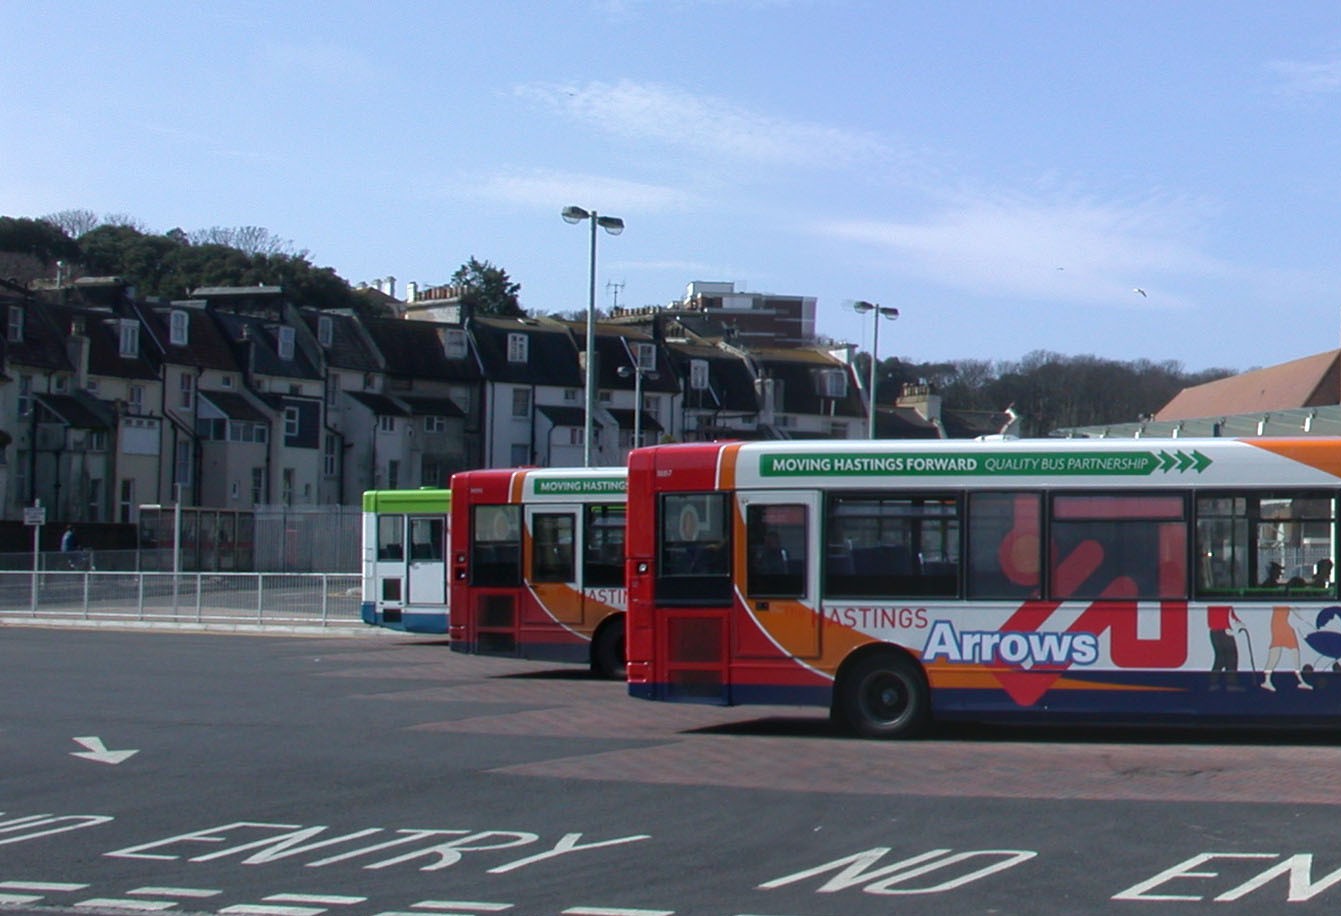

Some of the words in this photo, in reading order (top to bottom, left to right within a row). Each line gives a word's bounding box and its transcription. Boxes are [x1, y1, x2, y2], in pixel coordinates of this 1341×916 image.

[773, 458, 832, 472] MOVING
[834, 458, 904, 472] HASTINGS
[906, 458, 977, 471] FORWARD
[985, 458, 1040, 471] QUALITY
[1041, 458, 1066, 470] BUS
[1067, 457, 1149, 470] PARTNERSHIP
[541, 481, 581, 491] MOVING
[811, 607, 928, 629] HASTINGS
[920, 620, 1099, 664] Arrows
[0, 811, 115, 845] O
[102, 821, 653, 874] ENTRY
[755, 847, 1038, 894] NO
